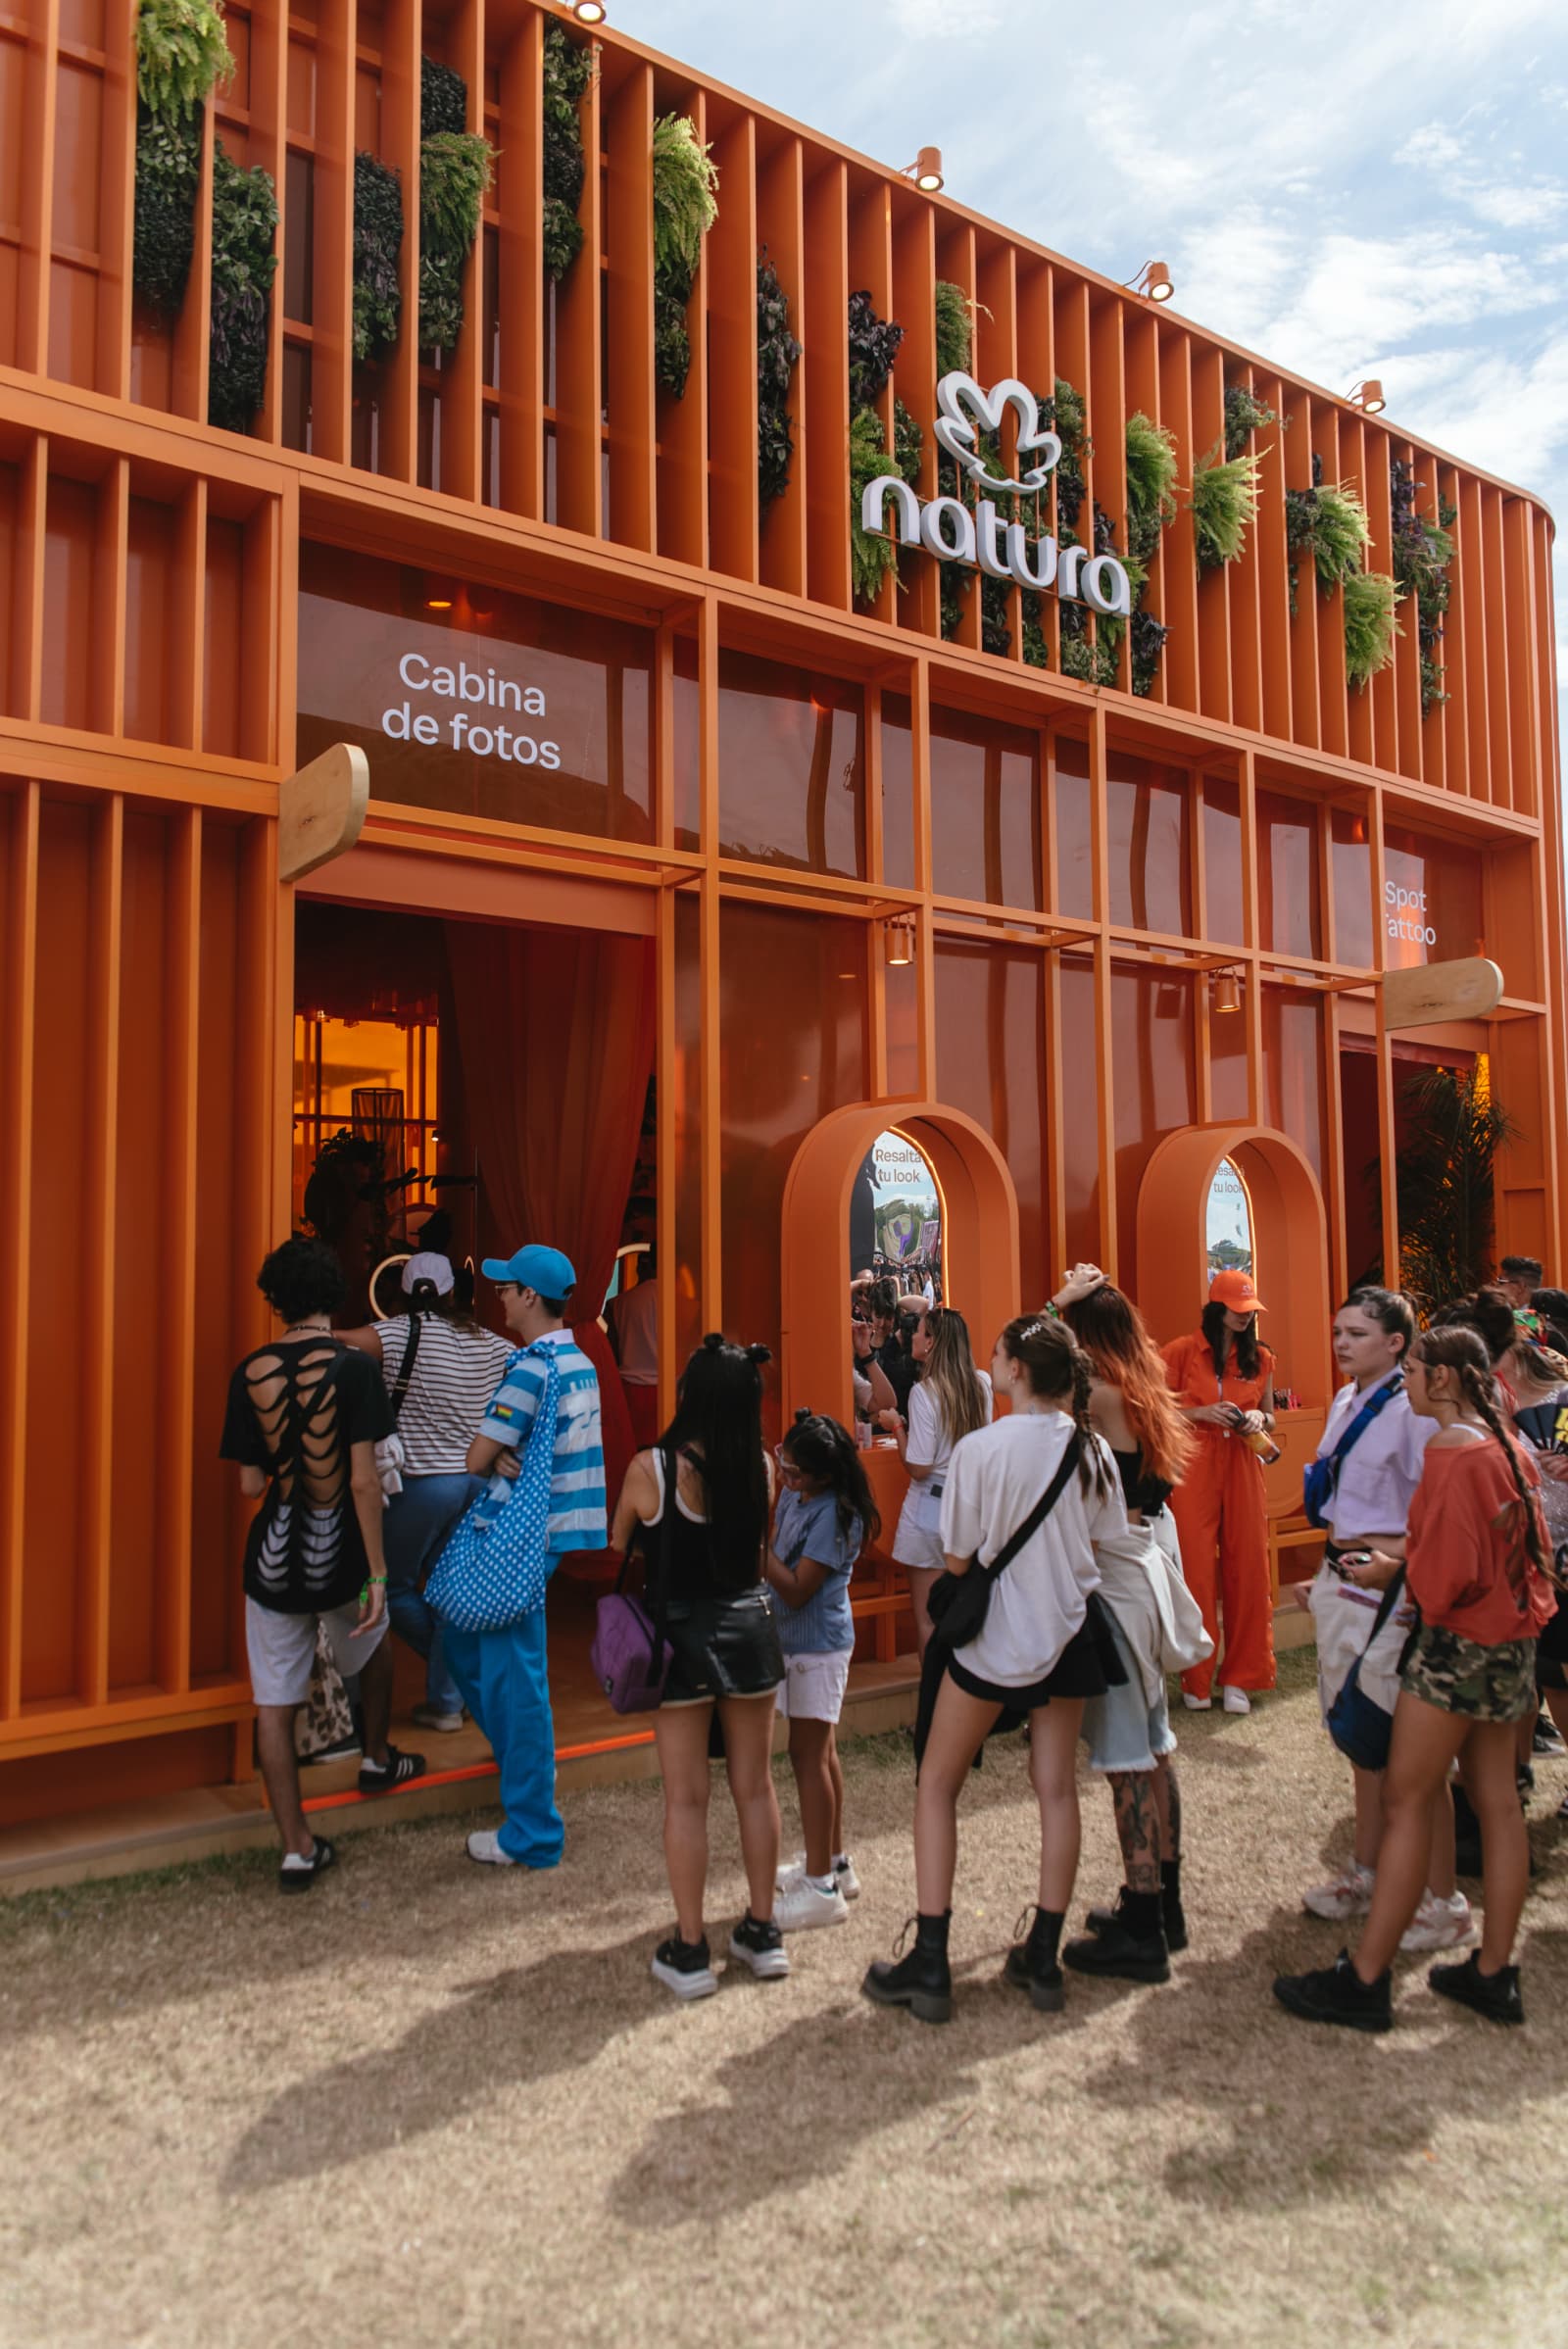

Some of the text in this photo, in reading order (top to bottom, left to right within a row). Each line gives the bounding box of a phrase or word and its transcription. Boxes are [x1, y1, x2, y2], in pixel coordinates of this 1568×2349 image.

[861, 475, 1131, 618] natura
[399, 653, 546, 716] Cabina
[381, 702, 562, 770] de fotos
[1385, 880, 1427, 911] Spot
[1385, 913, 1436, 945] attoo
[878, 1168, 920, 1183] tu look
[1213, 1181, 1223, 1193] tu
